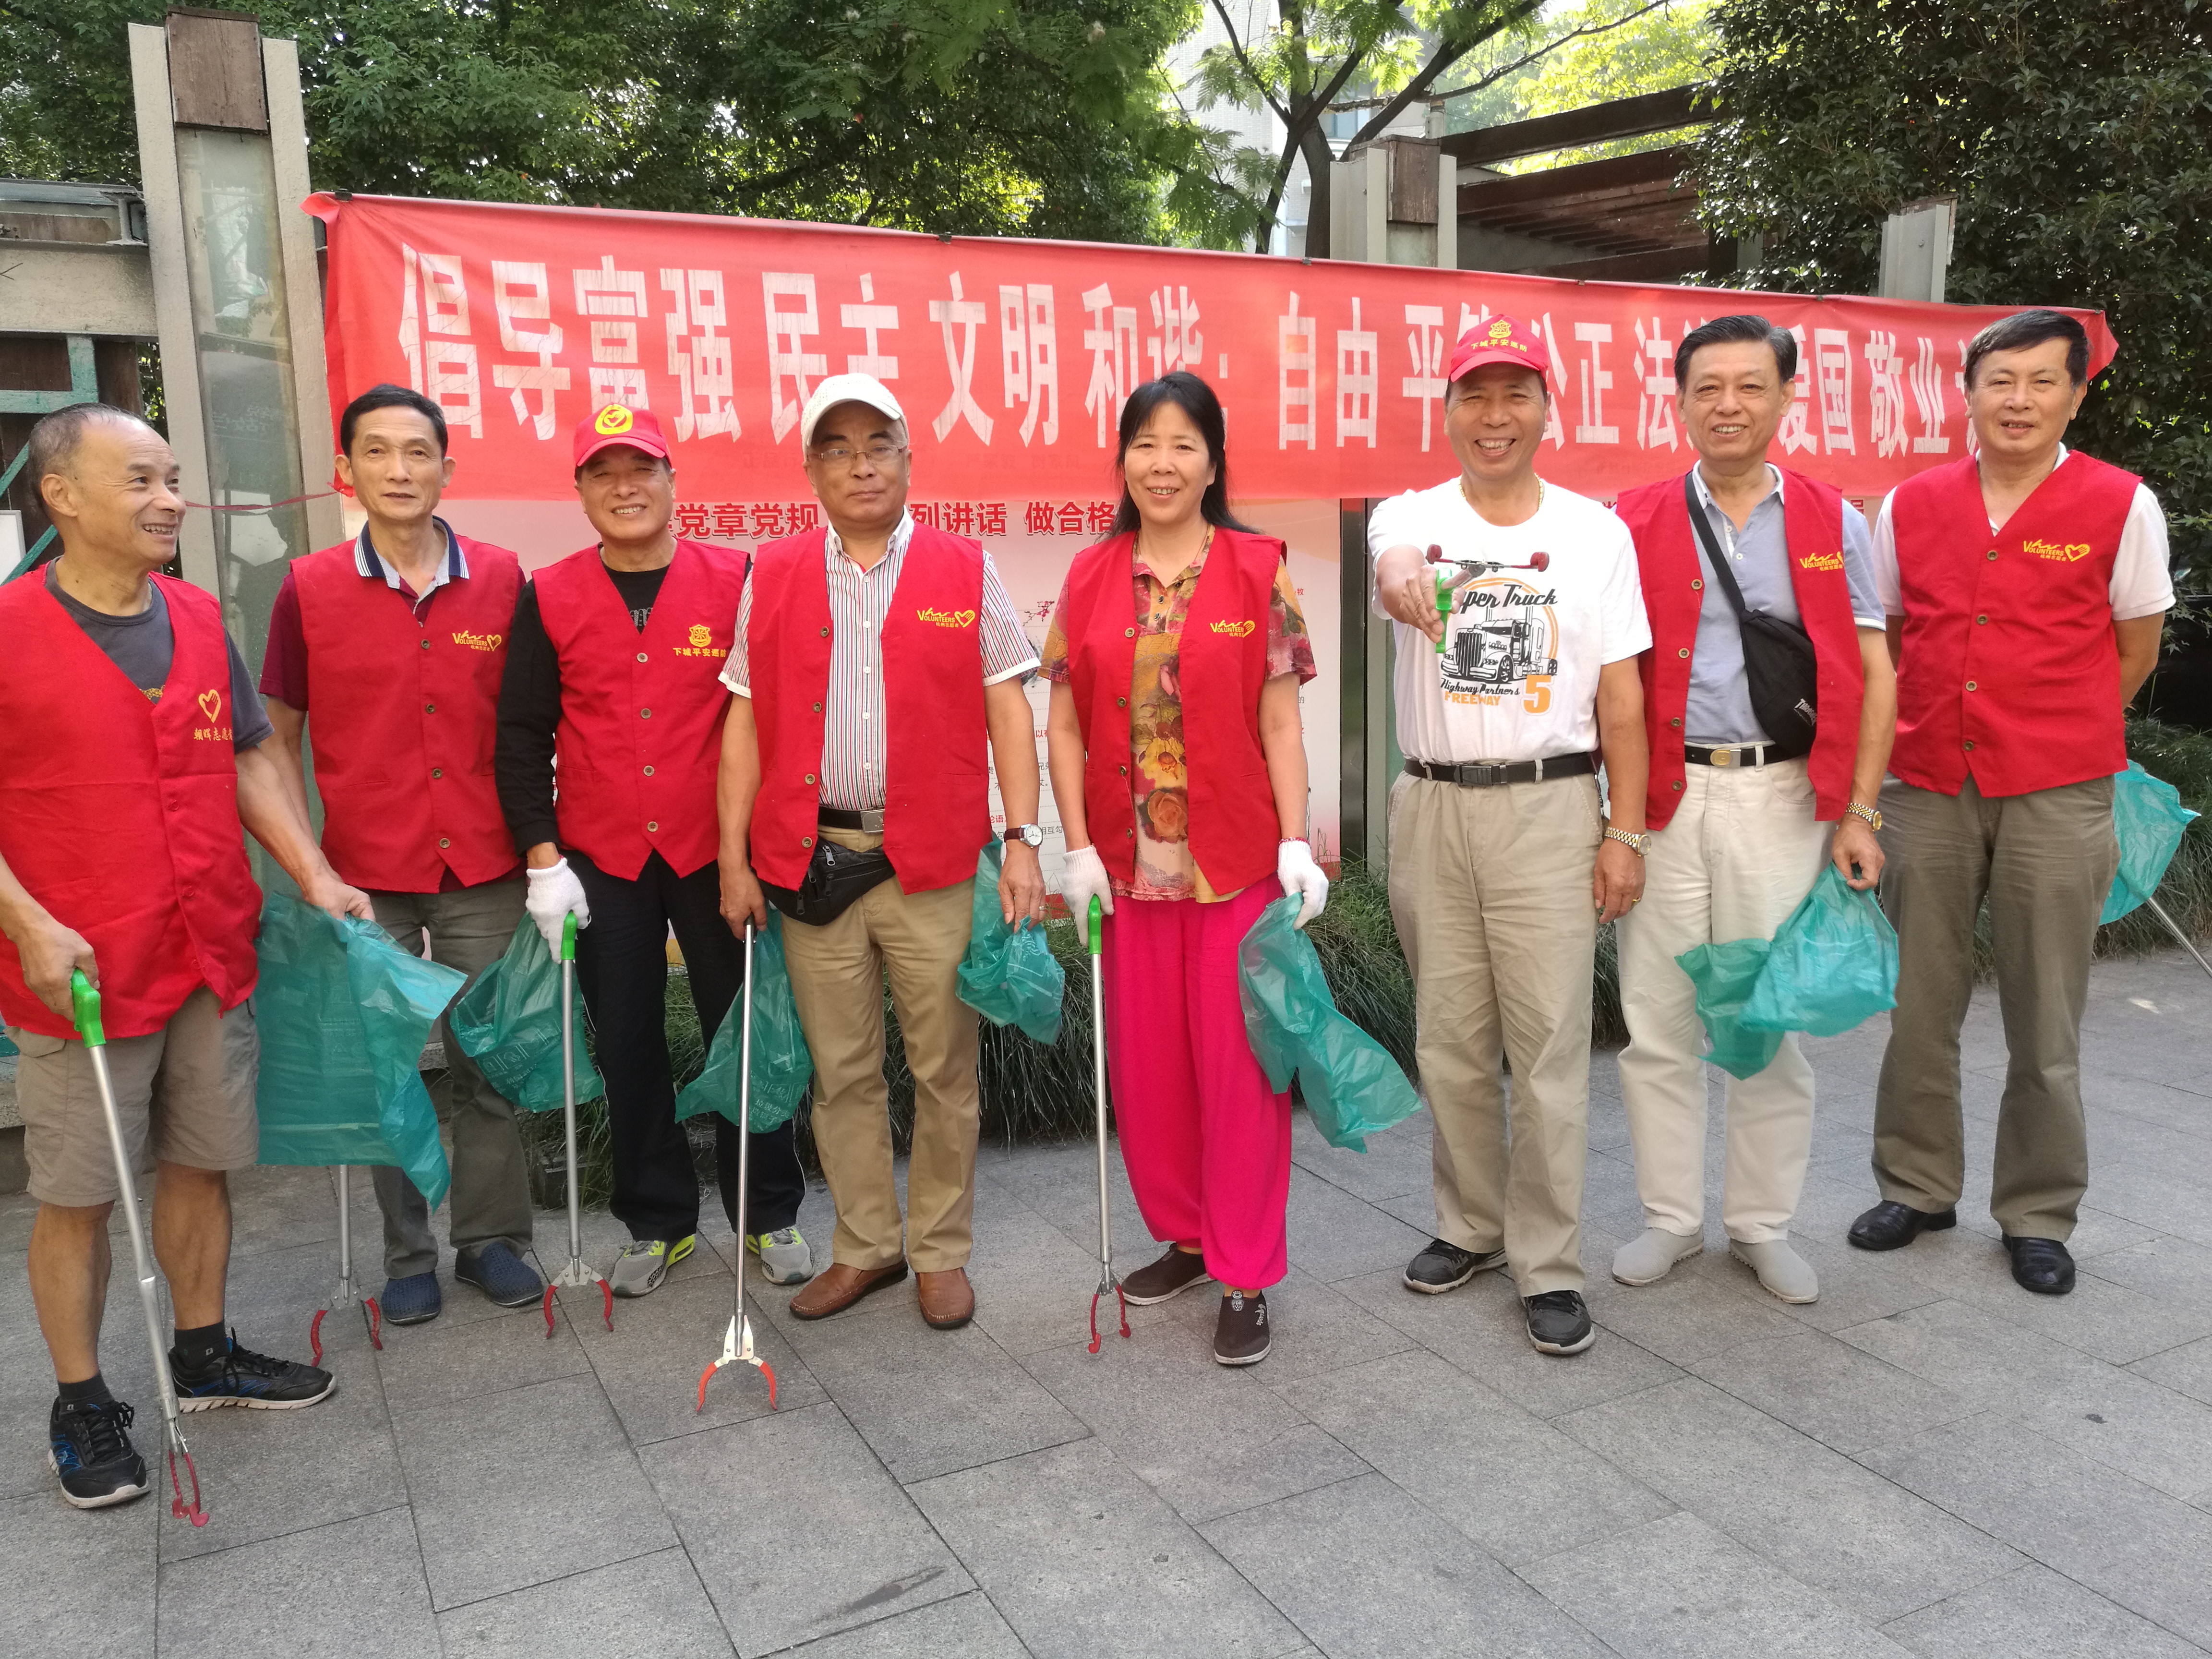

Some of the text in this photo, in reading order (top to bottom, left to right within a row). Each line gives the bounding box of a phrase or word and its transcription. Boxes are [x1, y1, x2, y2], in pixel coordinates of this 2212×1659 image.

[669, 503, 819, 539] 党章党规
[1460, 584, 1558, 614] per Truck
[1210, 623, 1244, 633] VOLUNTEER
[1440, 677, 1520, 696] Highway Partners
[1523, 674, 1552, 714] 5
[1444, 692, 1502, 706] FREEWAY
